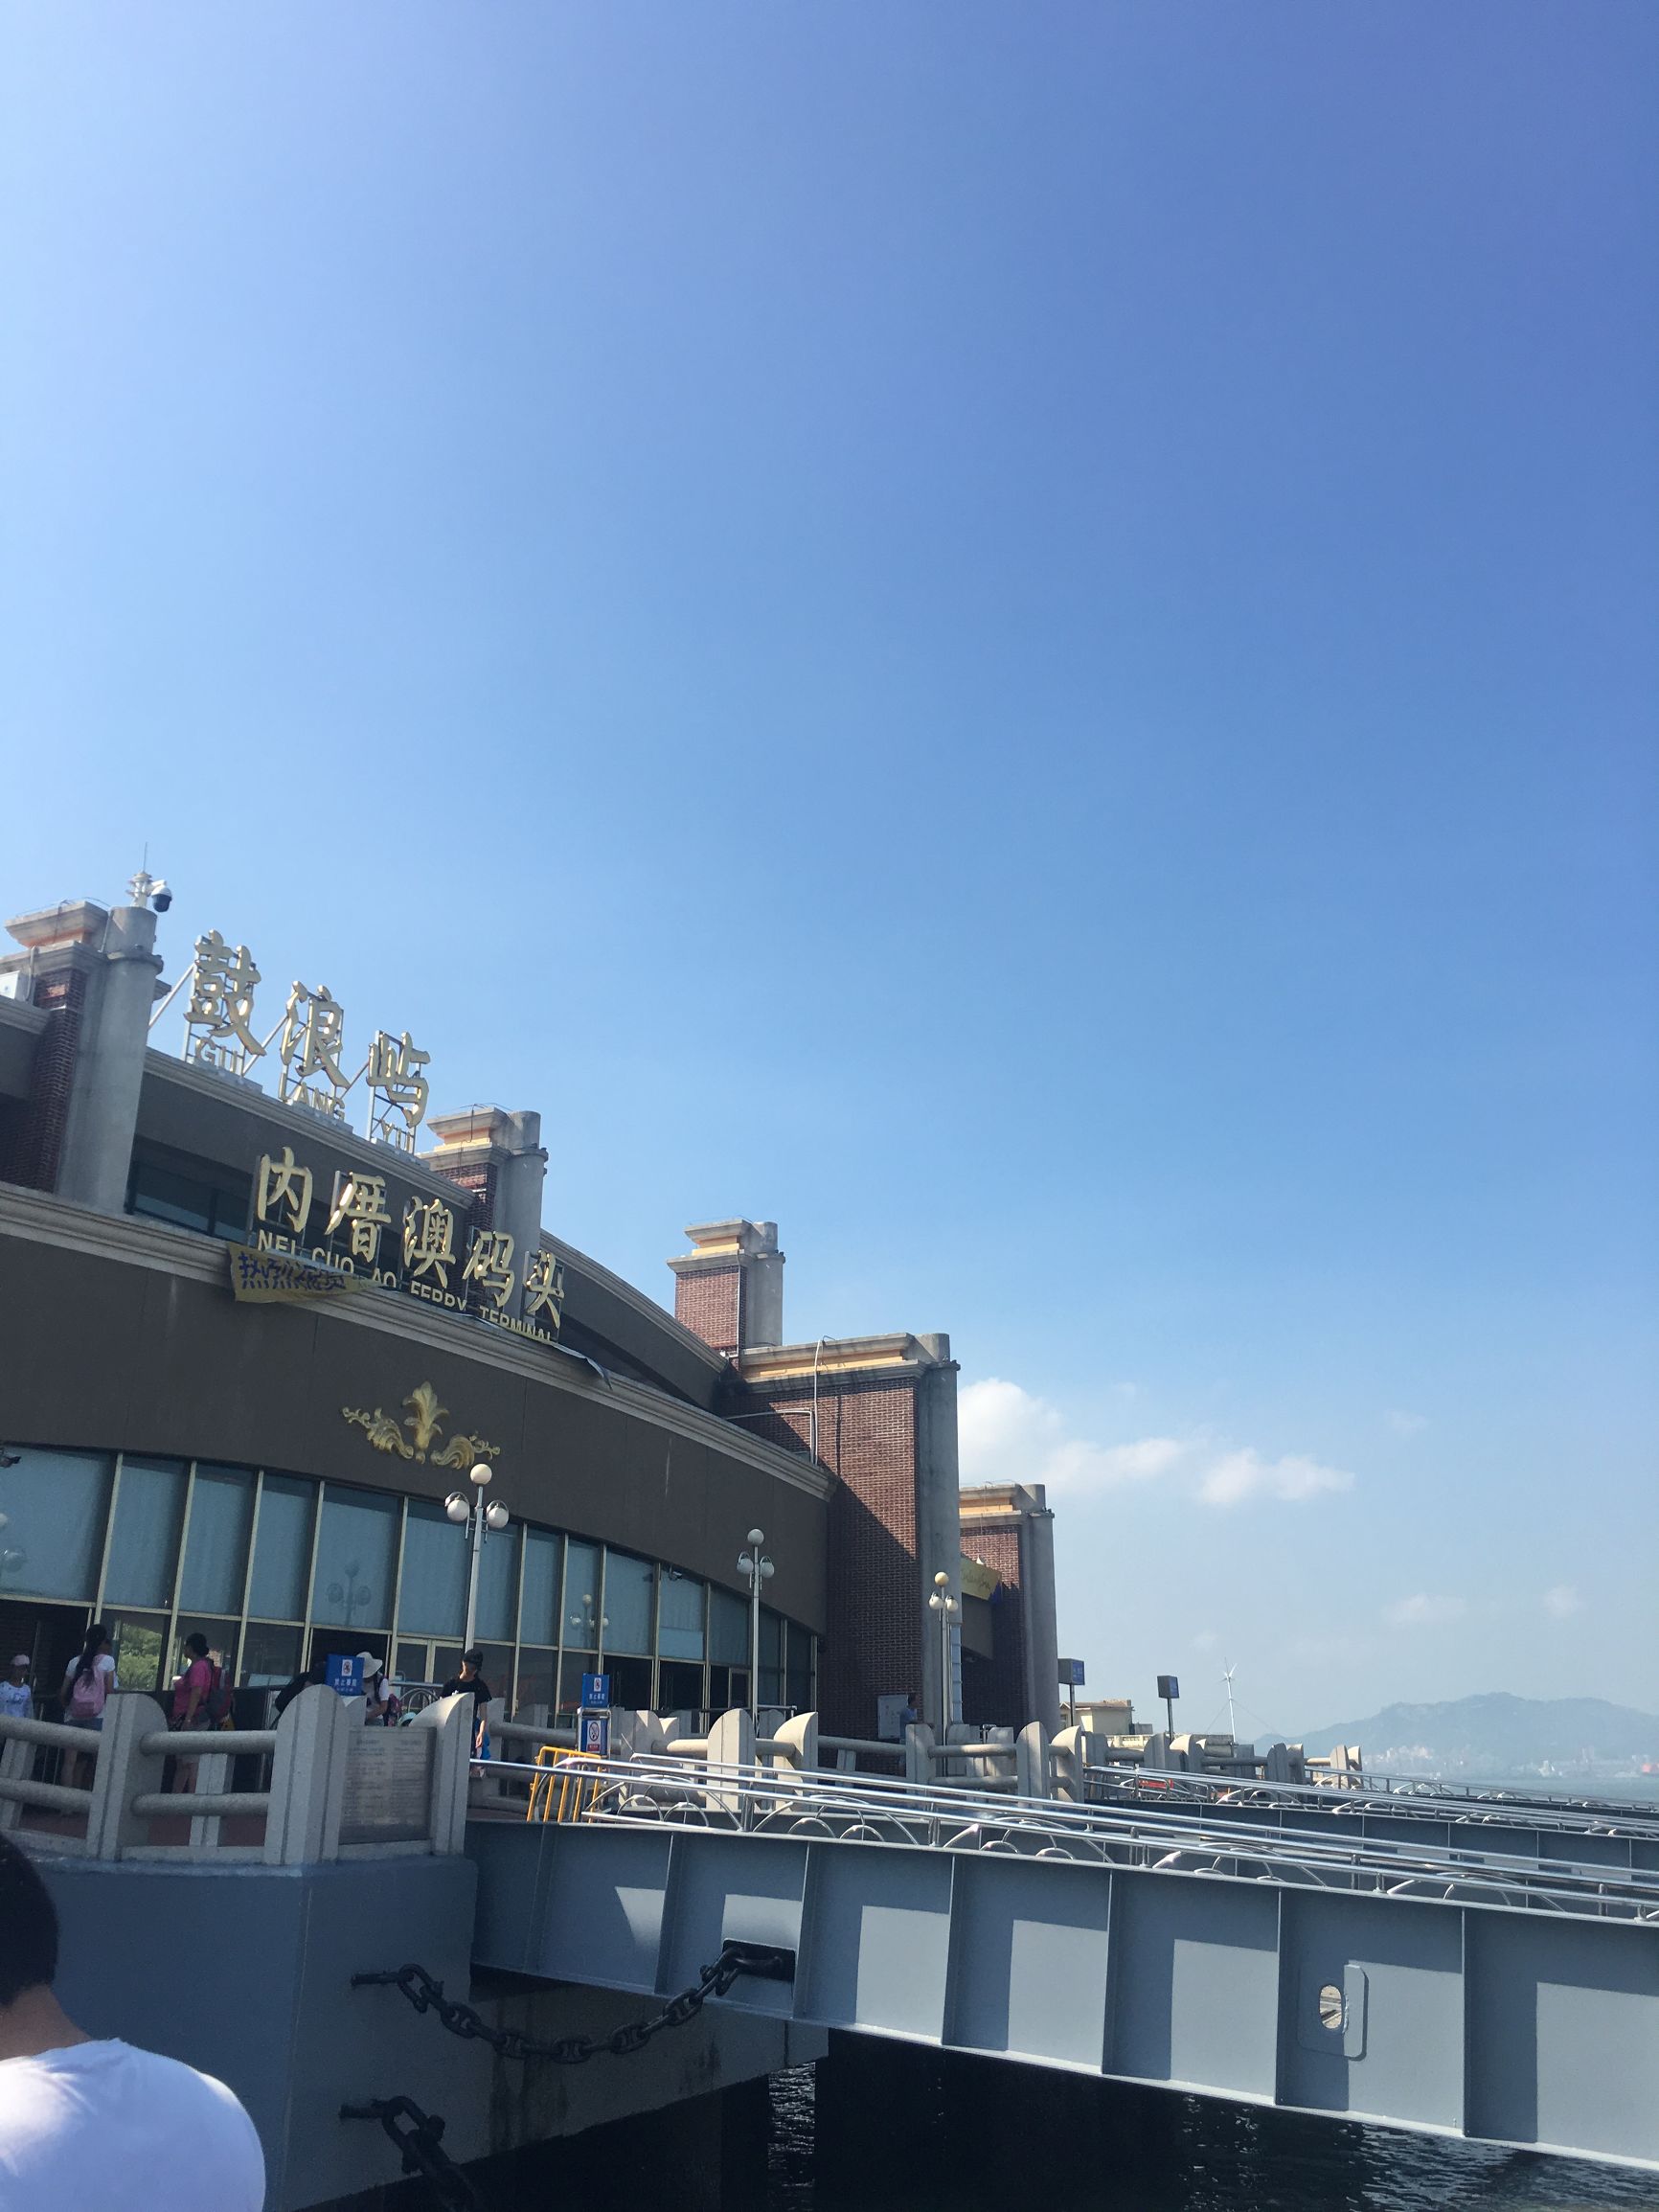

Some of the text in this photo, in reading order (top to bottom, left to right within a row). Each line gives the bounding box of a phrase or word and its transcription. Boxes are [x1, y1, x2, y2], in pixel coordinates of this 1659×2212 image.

[183, 928, 431, 1129] 鼓浪屿
[195, 1037, 413, 1153] GU LANG YU
[258, 1146, 565, 1330] 内厝澳码头
